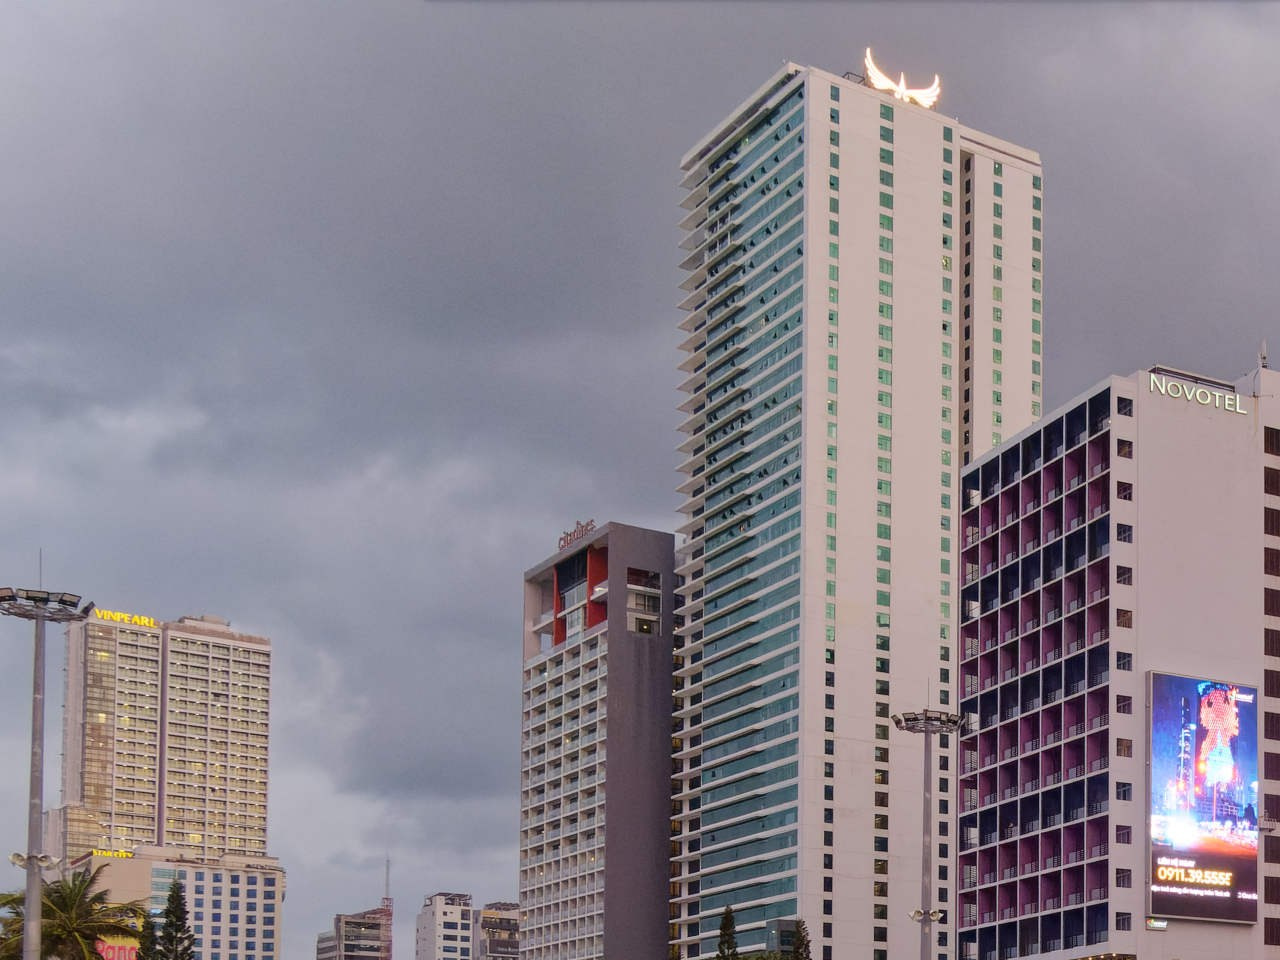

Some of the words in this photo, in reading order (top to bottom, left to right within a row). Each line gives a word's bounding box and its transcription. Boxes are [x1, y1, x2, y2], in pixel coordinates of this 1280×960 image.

[1150, 373, 1248, 414] NOVOTEL
[94, 607, 159, 629] VINPEARL
[92, 848, 112, 857] STAR
[113, 850, 134, 858] CITY
